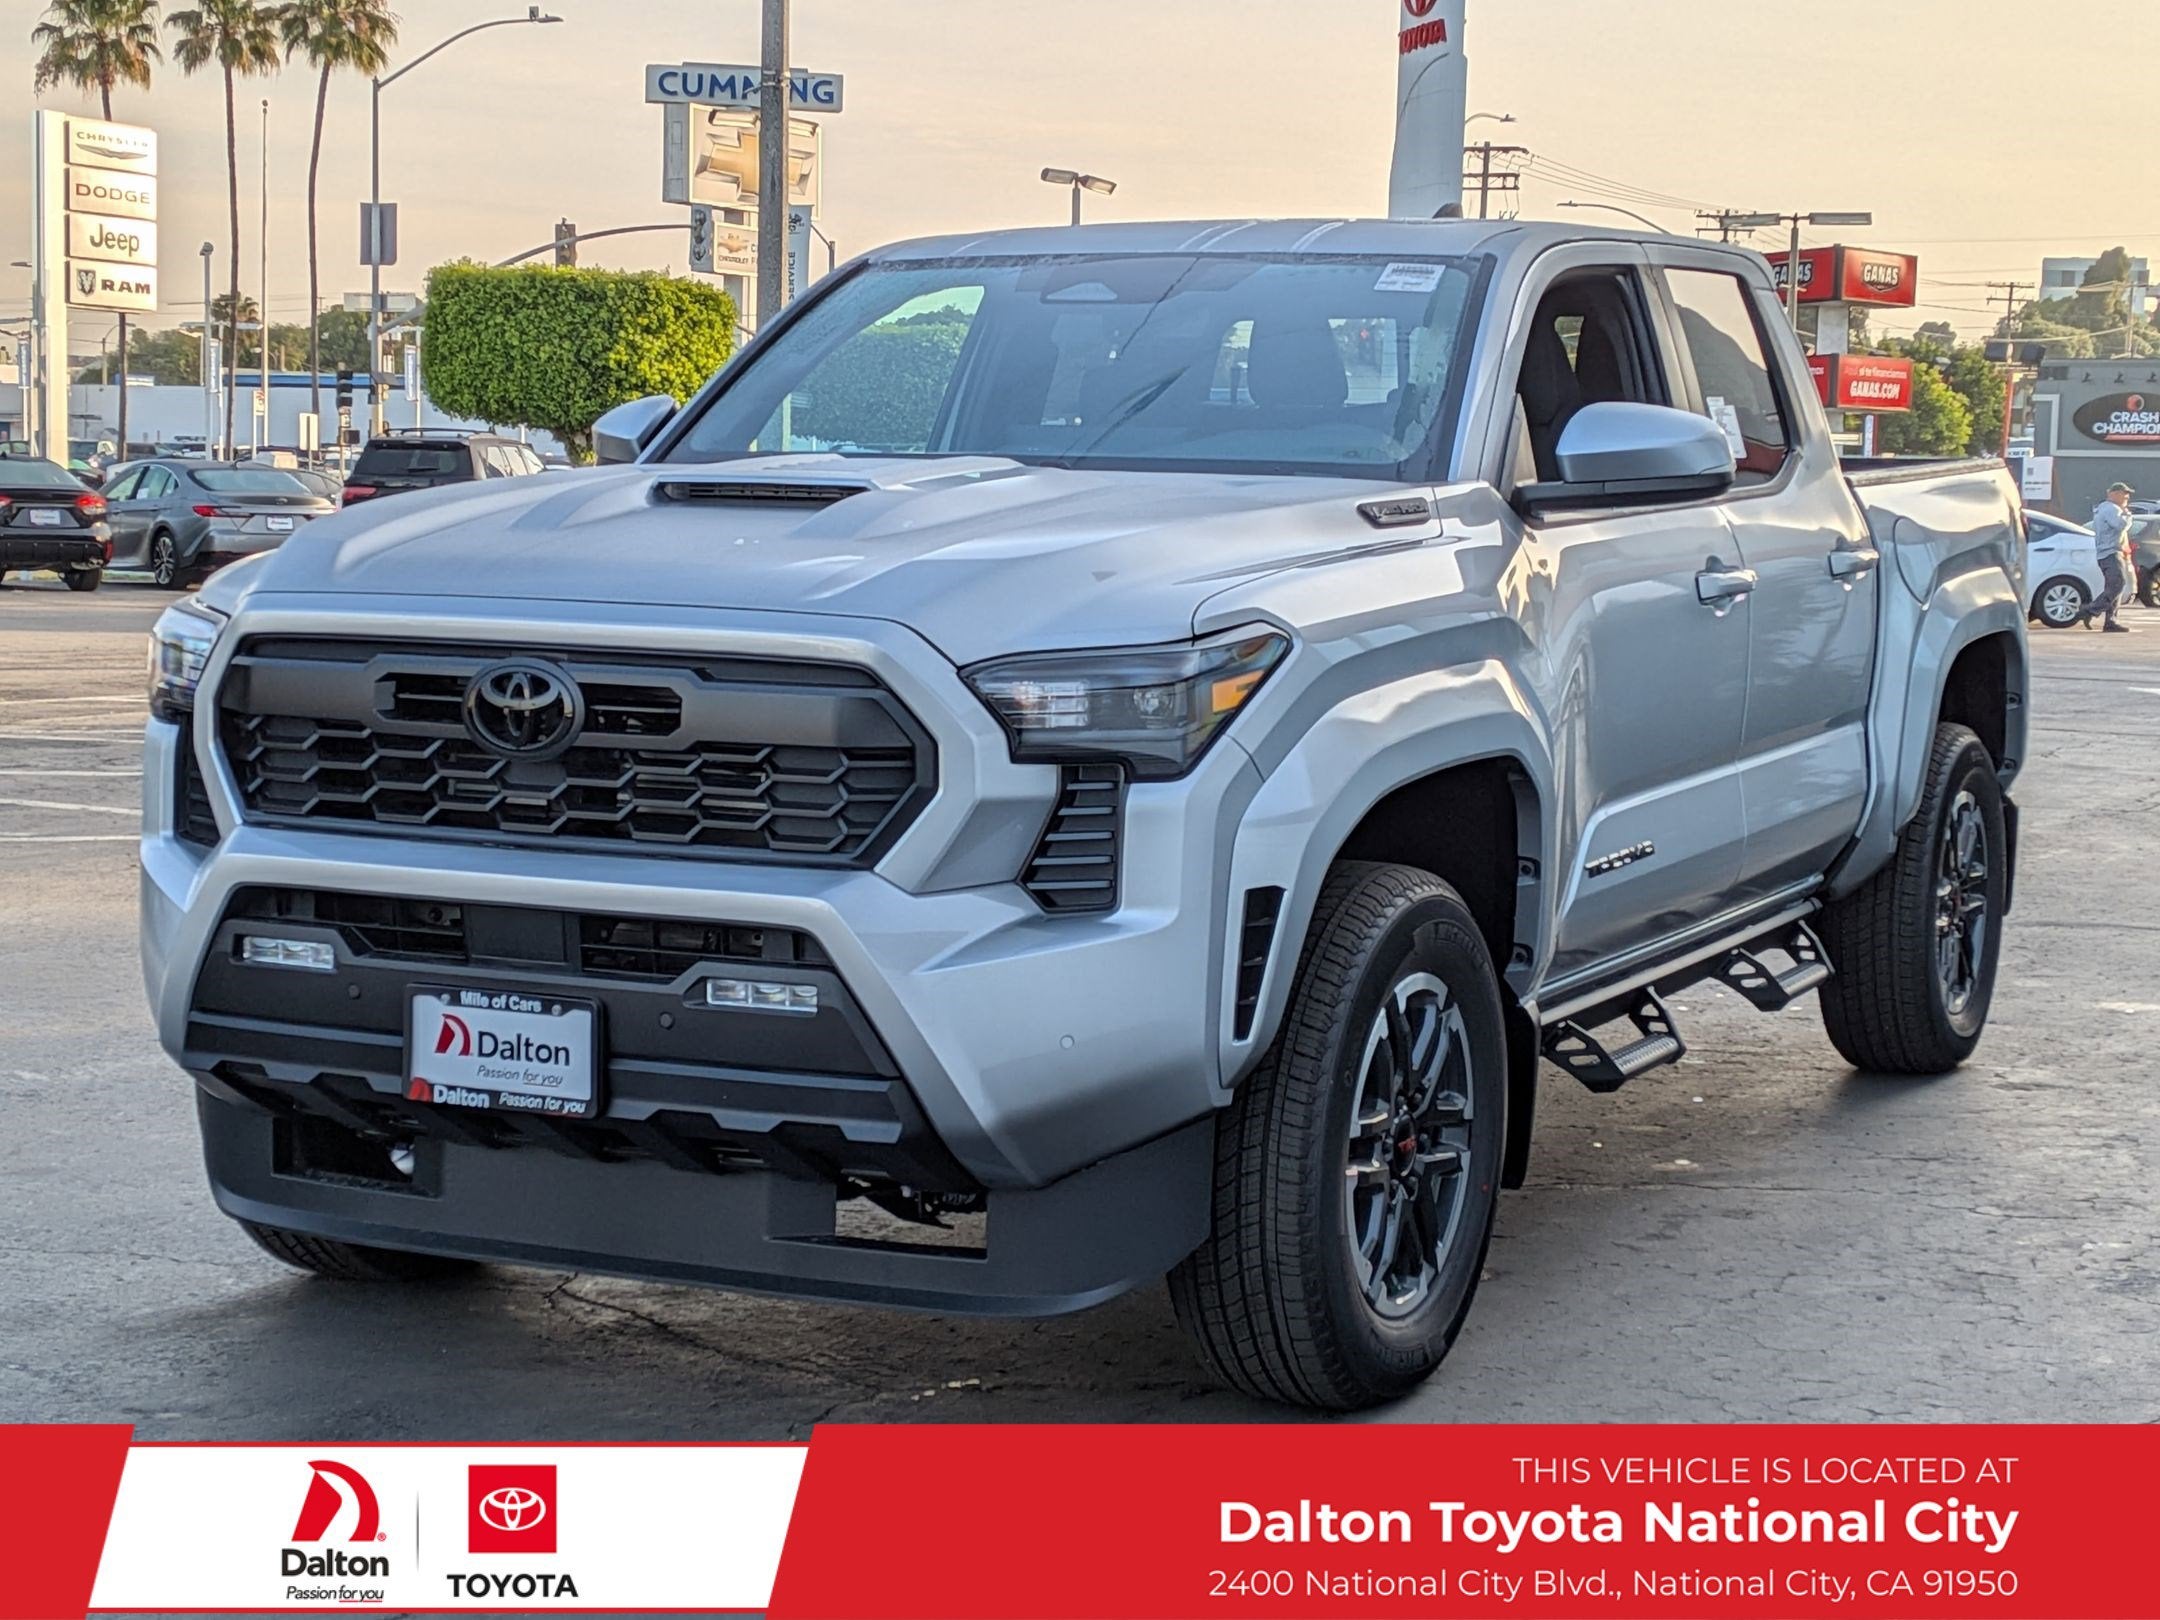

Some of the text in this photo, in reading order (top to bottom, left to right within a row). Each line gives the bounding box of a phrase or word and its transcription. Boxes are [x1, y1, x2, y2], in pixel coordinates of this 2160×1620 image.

[1398, 18, 1447, 55] TOYOTA
[658, 71, 834, 104] CUMMNG
[76, 183, 151, 204] DODGE
[90, 223, 140, 257] Jeep
[1773, 263, 1812, 283] GAAS
[1863, 263, 1899, 285] GANAS
[101, 279, 151, 294] RAM
[1850, 380, 1900, 399] GANAS.COM
[2110, 411, 2160, 423] CRASH
[460, 991, 542, 1012] Mile of Cars
[478, 1031, 570, 1066] Dalton
[477, 1065, 563, 1087] Passion for you
[433, 1085, 586, 1114] Dalton Passion for you
